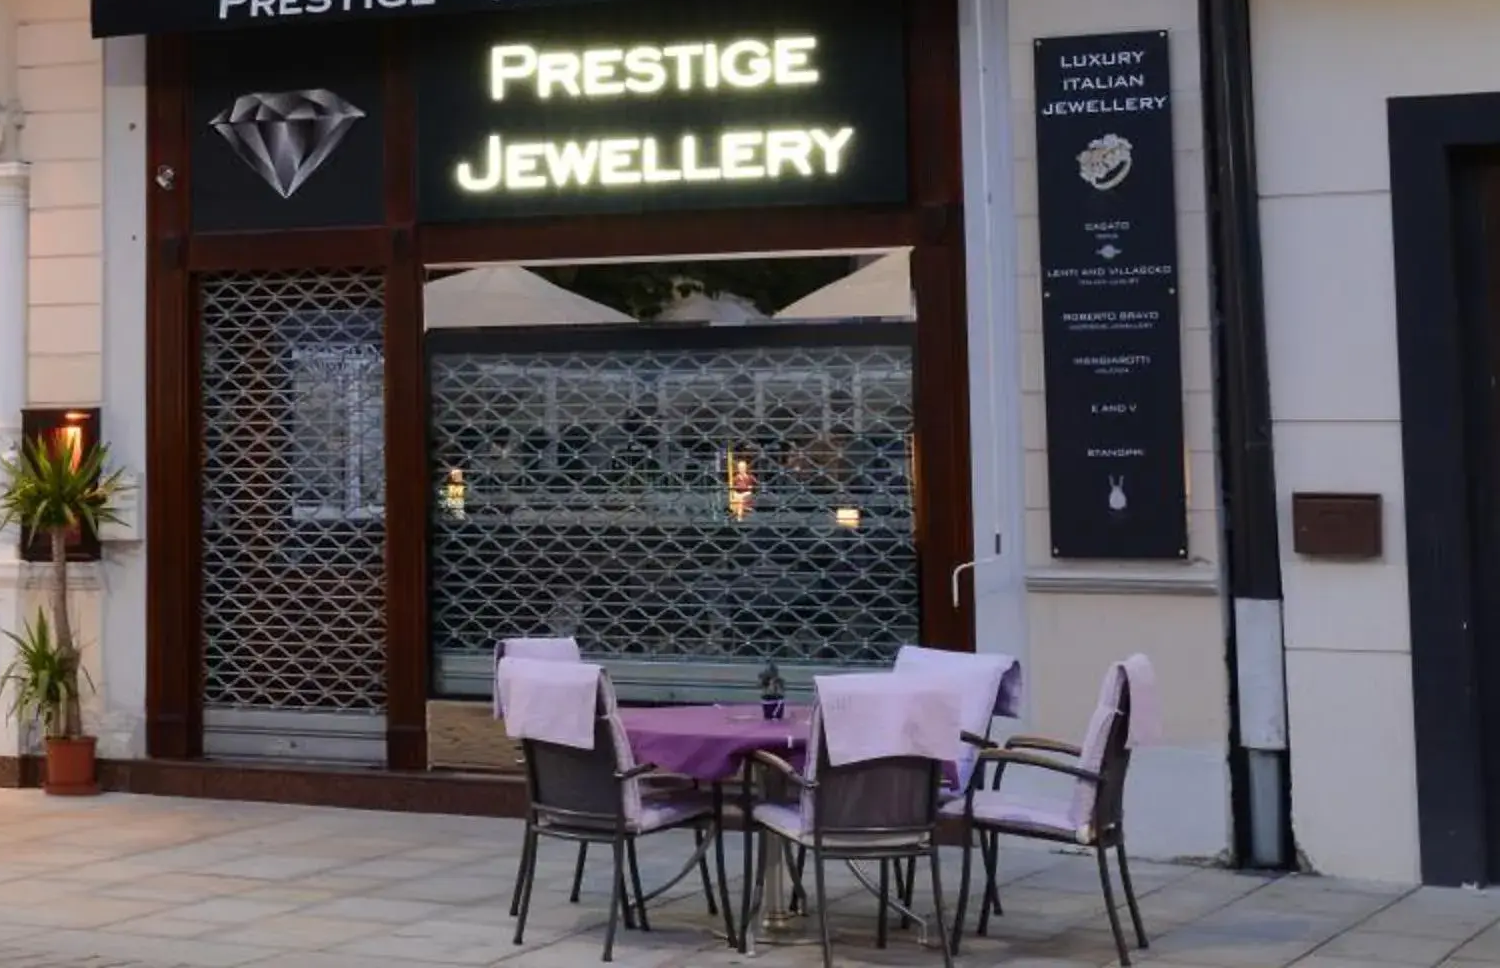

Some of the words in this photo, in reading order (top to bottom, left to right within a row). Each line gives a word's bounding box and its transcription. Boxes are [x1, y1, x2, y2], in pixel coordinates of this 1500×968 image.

[490, 36, 820, 101] PRESTIGE
[1059, 50, 1145, 69] LUXURY
[1062, 73, 1145, 91] ITALIAN
[1041, 95, 1168, 116] JEWELLERY
[457, 127, 854, 192] JEWELLERY
